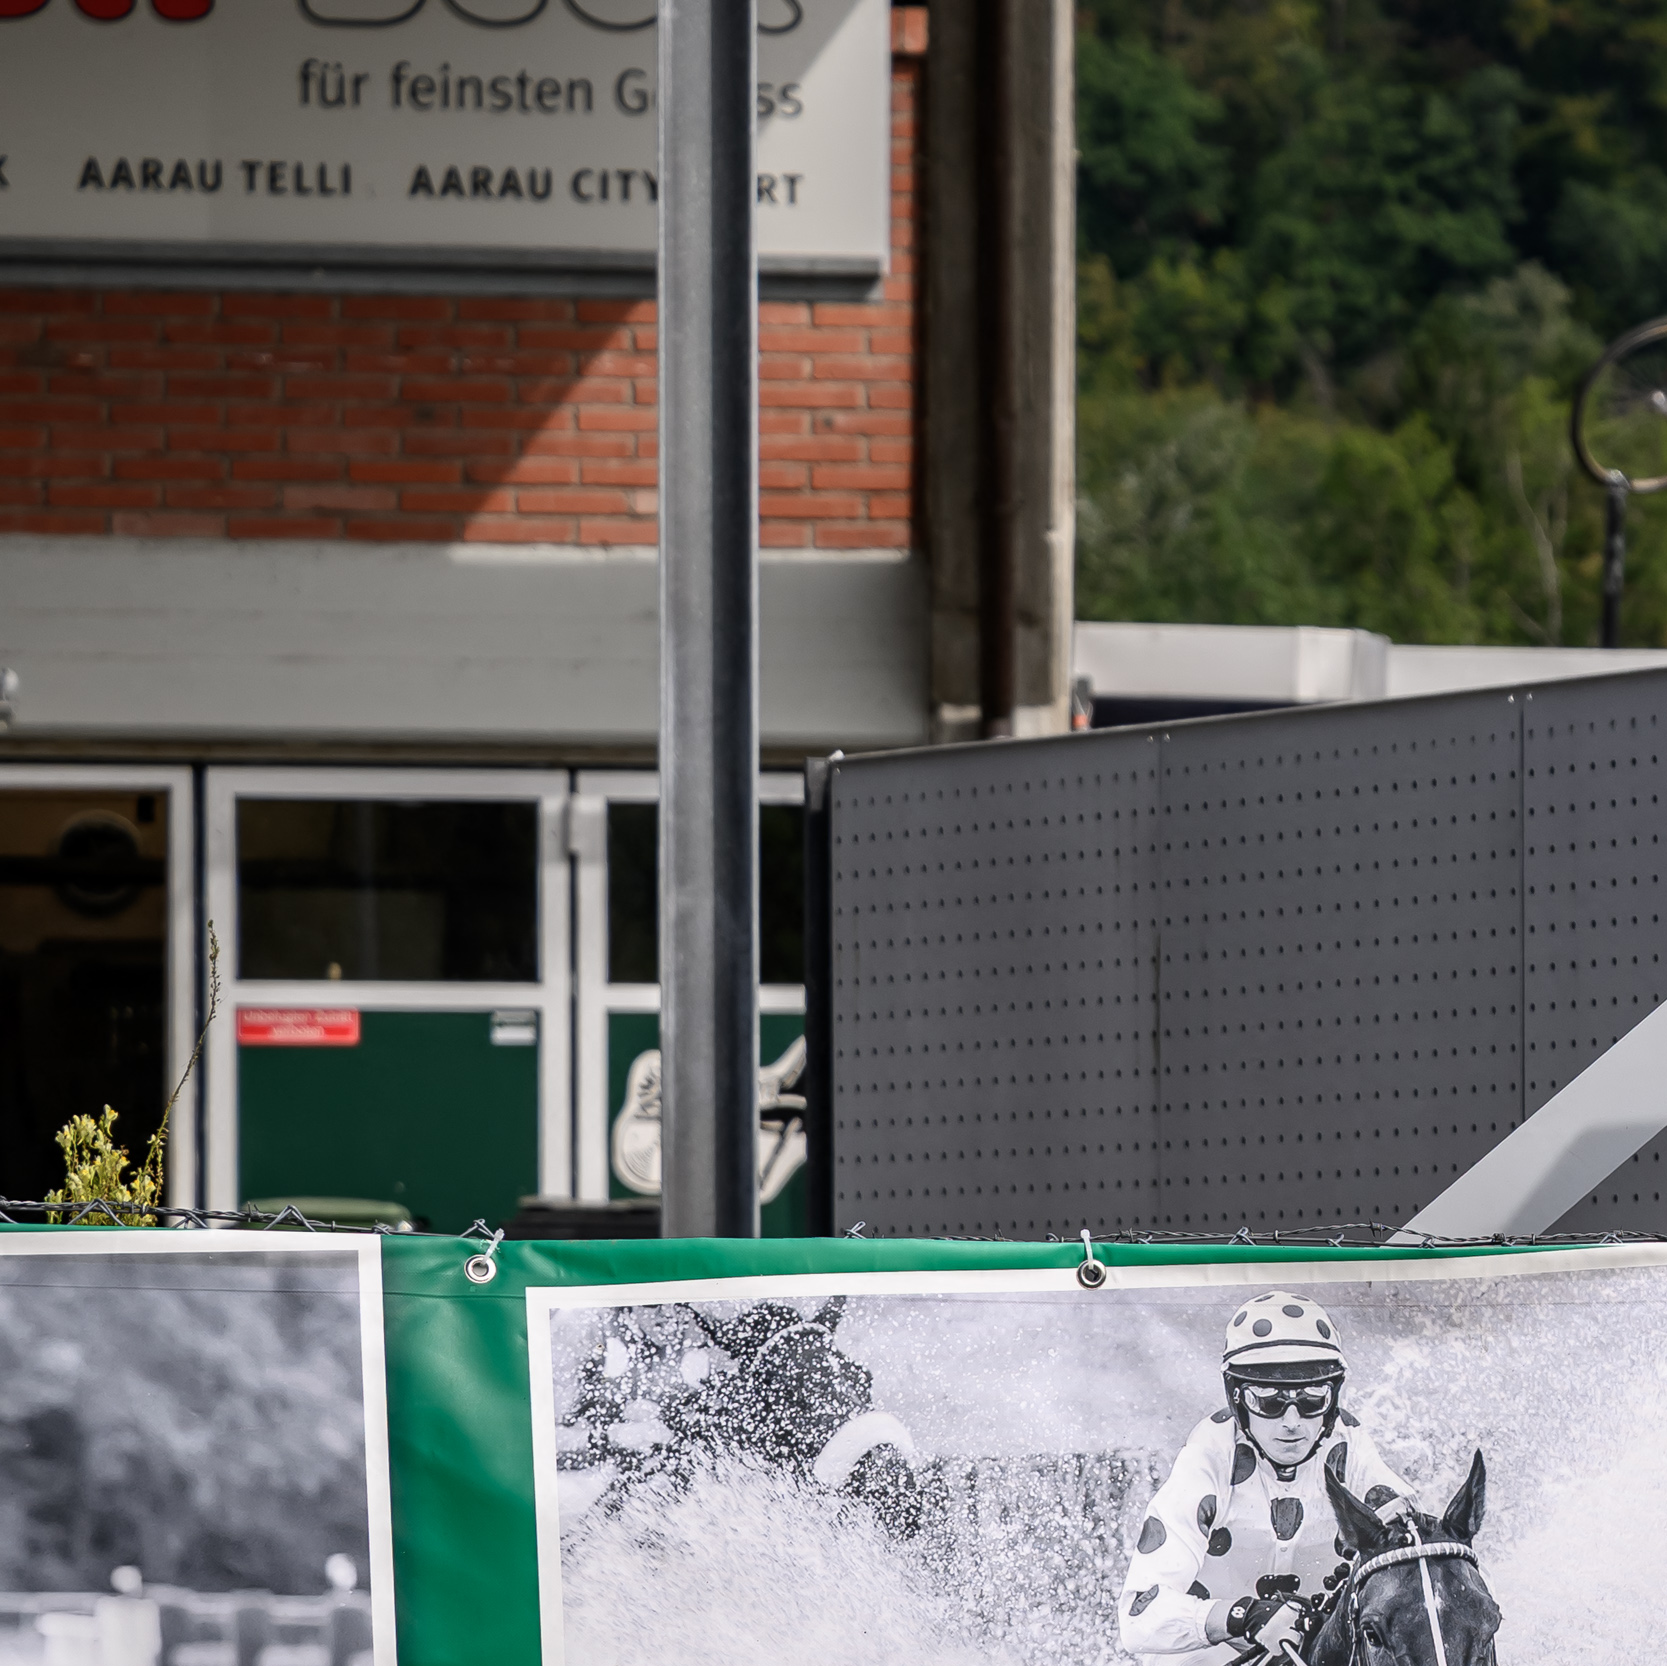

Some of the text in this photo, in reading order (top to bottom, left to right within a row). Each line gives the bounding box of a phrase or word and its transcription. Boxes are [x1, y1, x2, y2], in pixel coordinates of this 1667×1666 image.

[300, 57, 370, 107] für
[390, 60, 594, 112] feinsten
[76, 156, 353, 195] AARAU TELLI
[410, 165, 552, 199] AARAU
